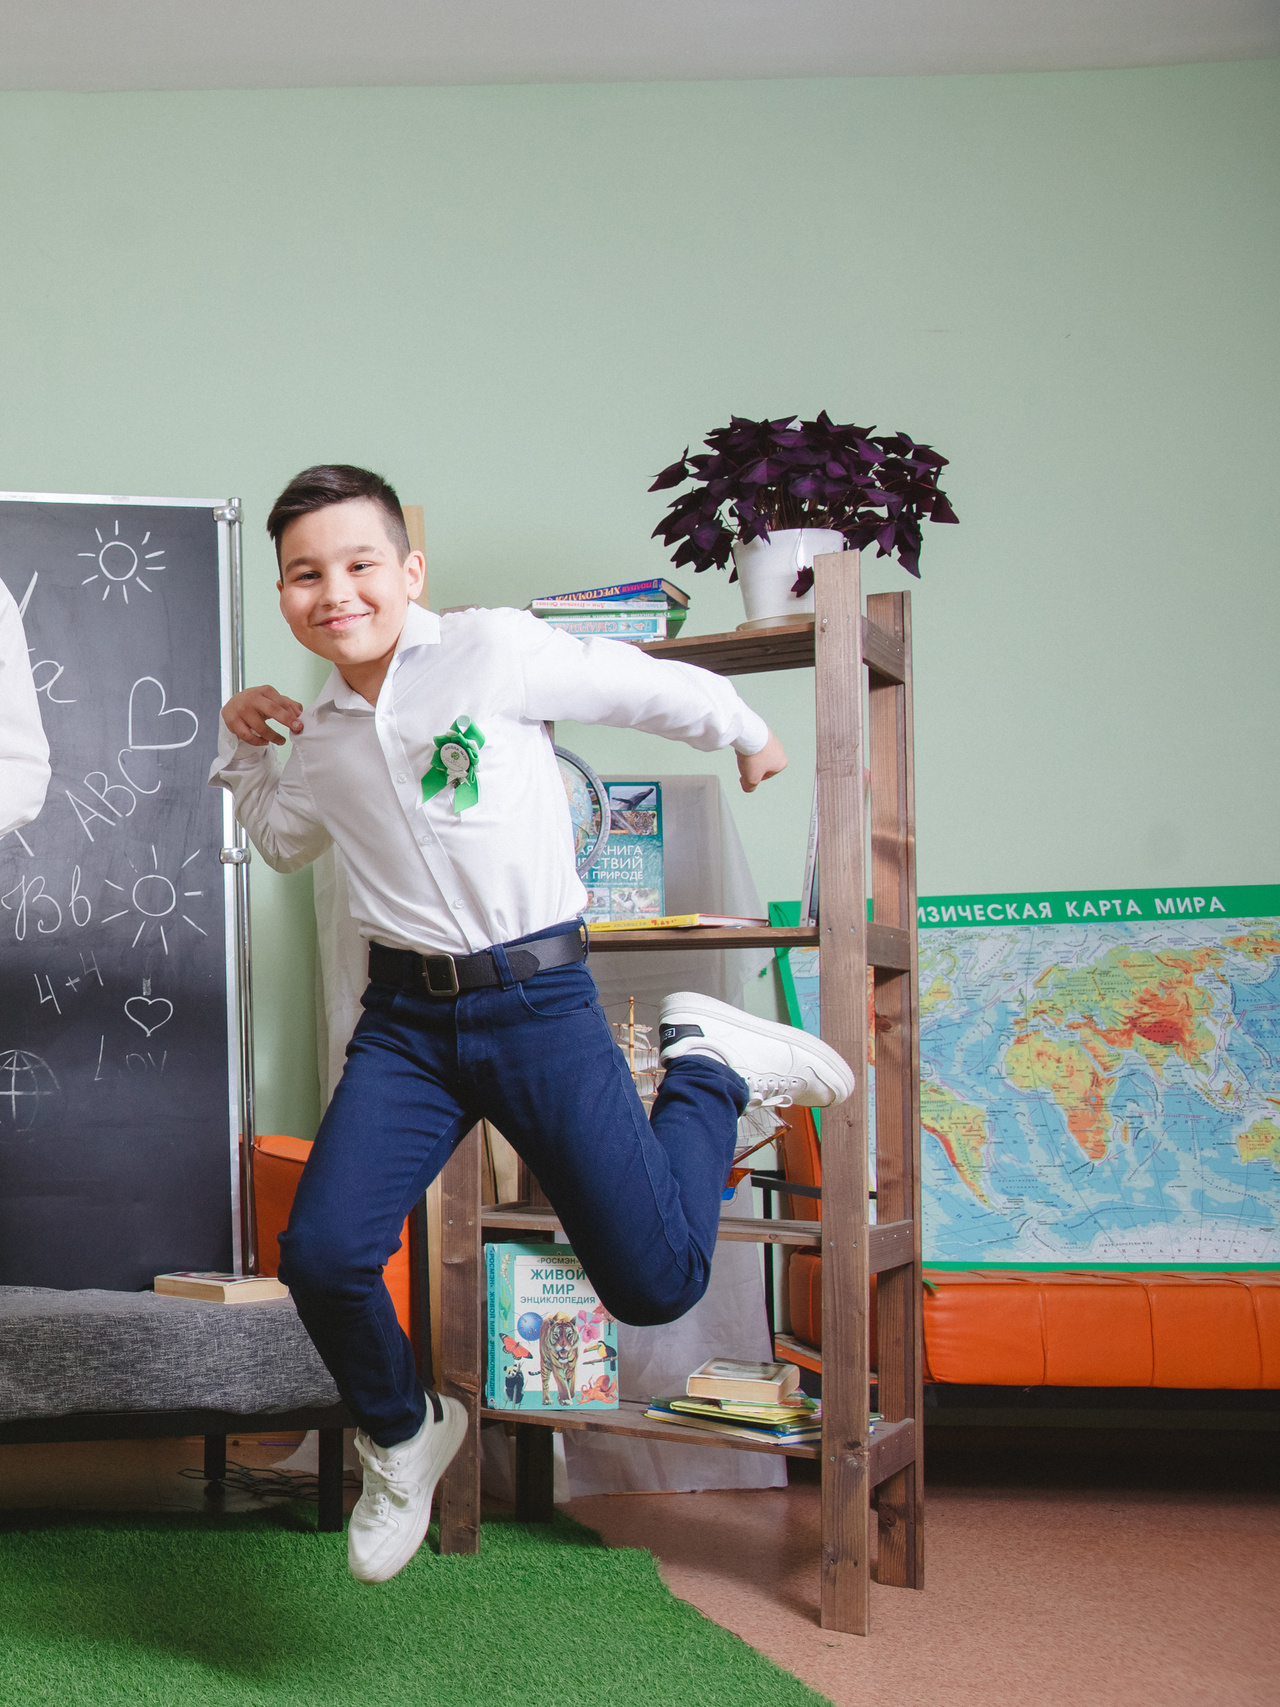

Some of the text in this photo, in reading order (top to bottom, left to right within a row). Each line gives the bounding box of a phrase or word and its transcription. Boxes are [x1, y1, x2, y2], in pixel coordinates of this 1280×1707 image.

[622, 581, 652, 593] ПОЛНАЯ
[592, 871, 644, 881] ПРИРОДЕ
[917, 896, 1227, 923] ИЗИЧЕСКАЯ КАРТА МИРА
[530, 1267, 586, 1281] ЖИВОЙ
[542, 1284, 575, 1295] МИР
[520, 1296, 596, 1305] ЭНЦИКЛОПЕДИЯ
